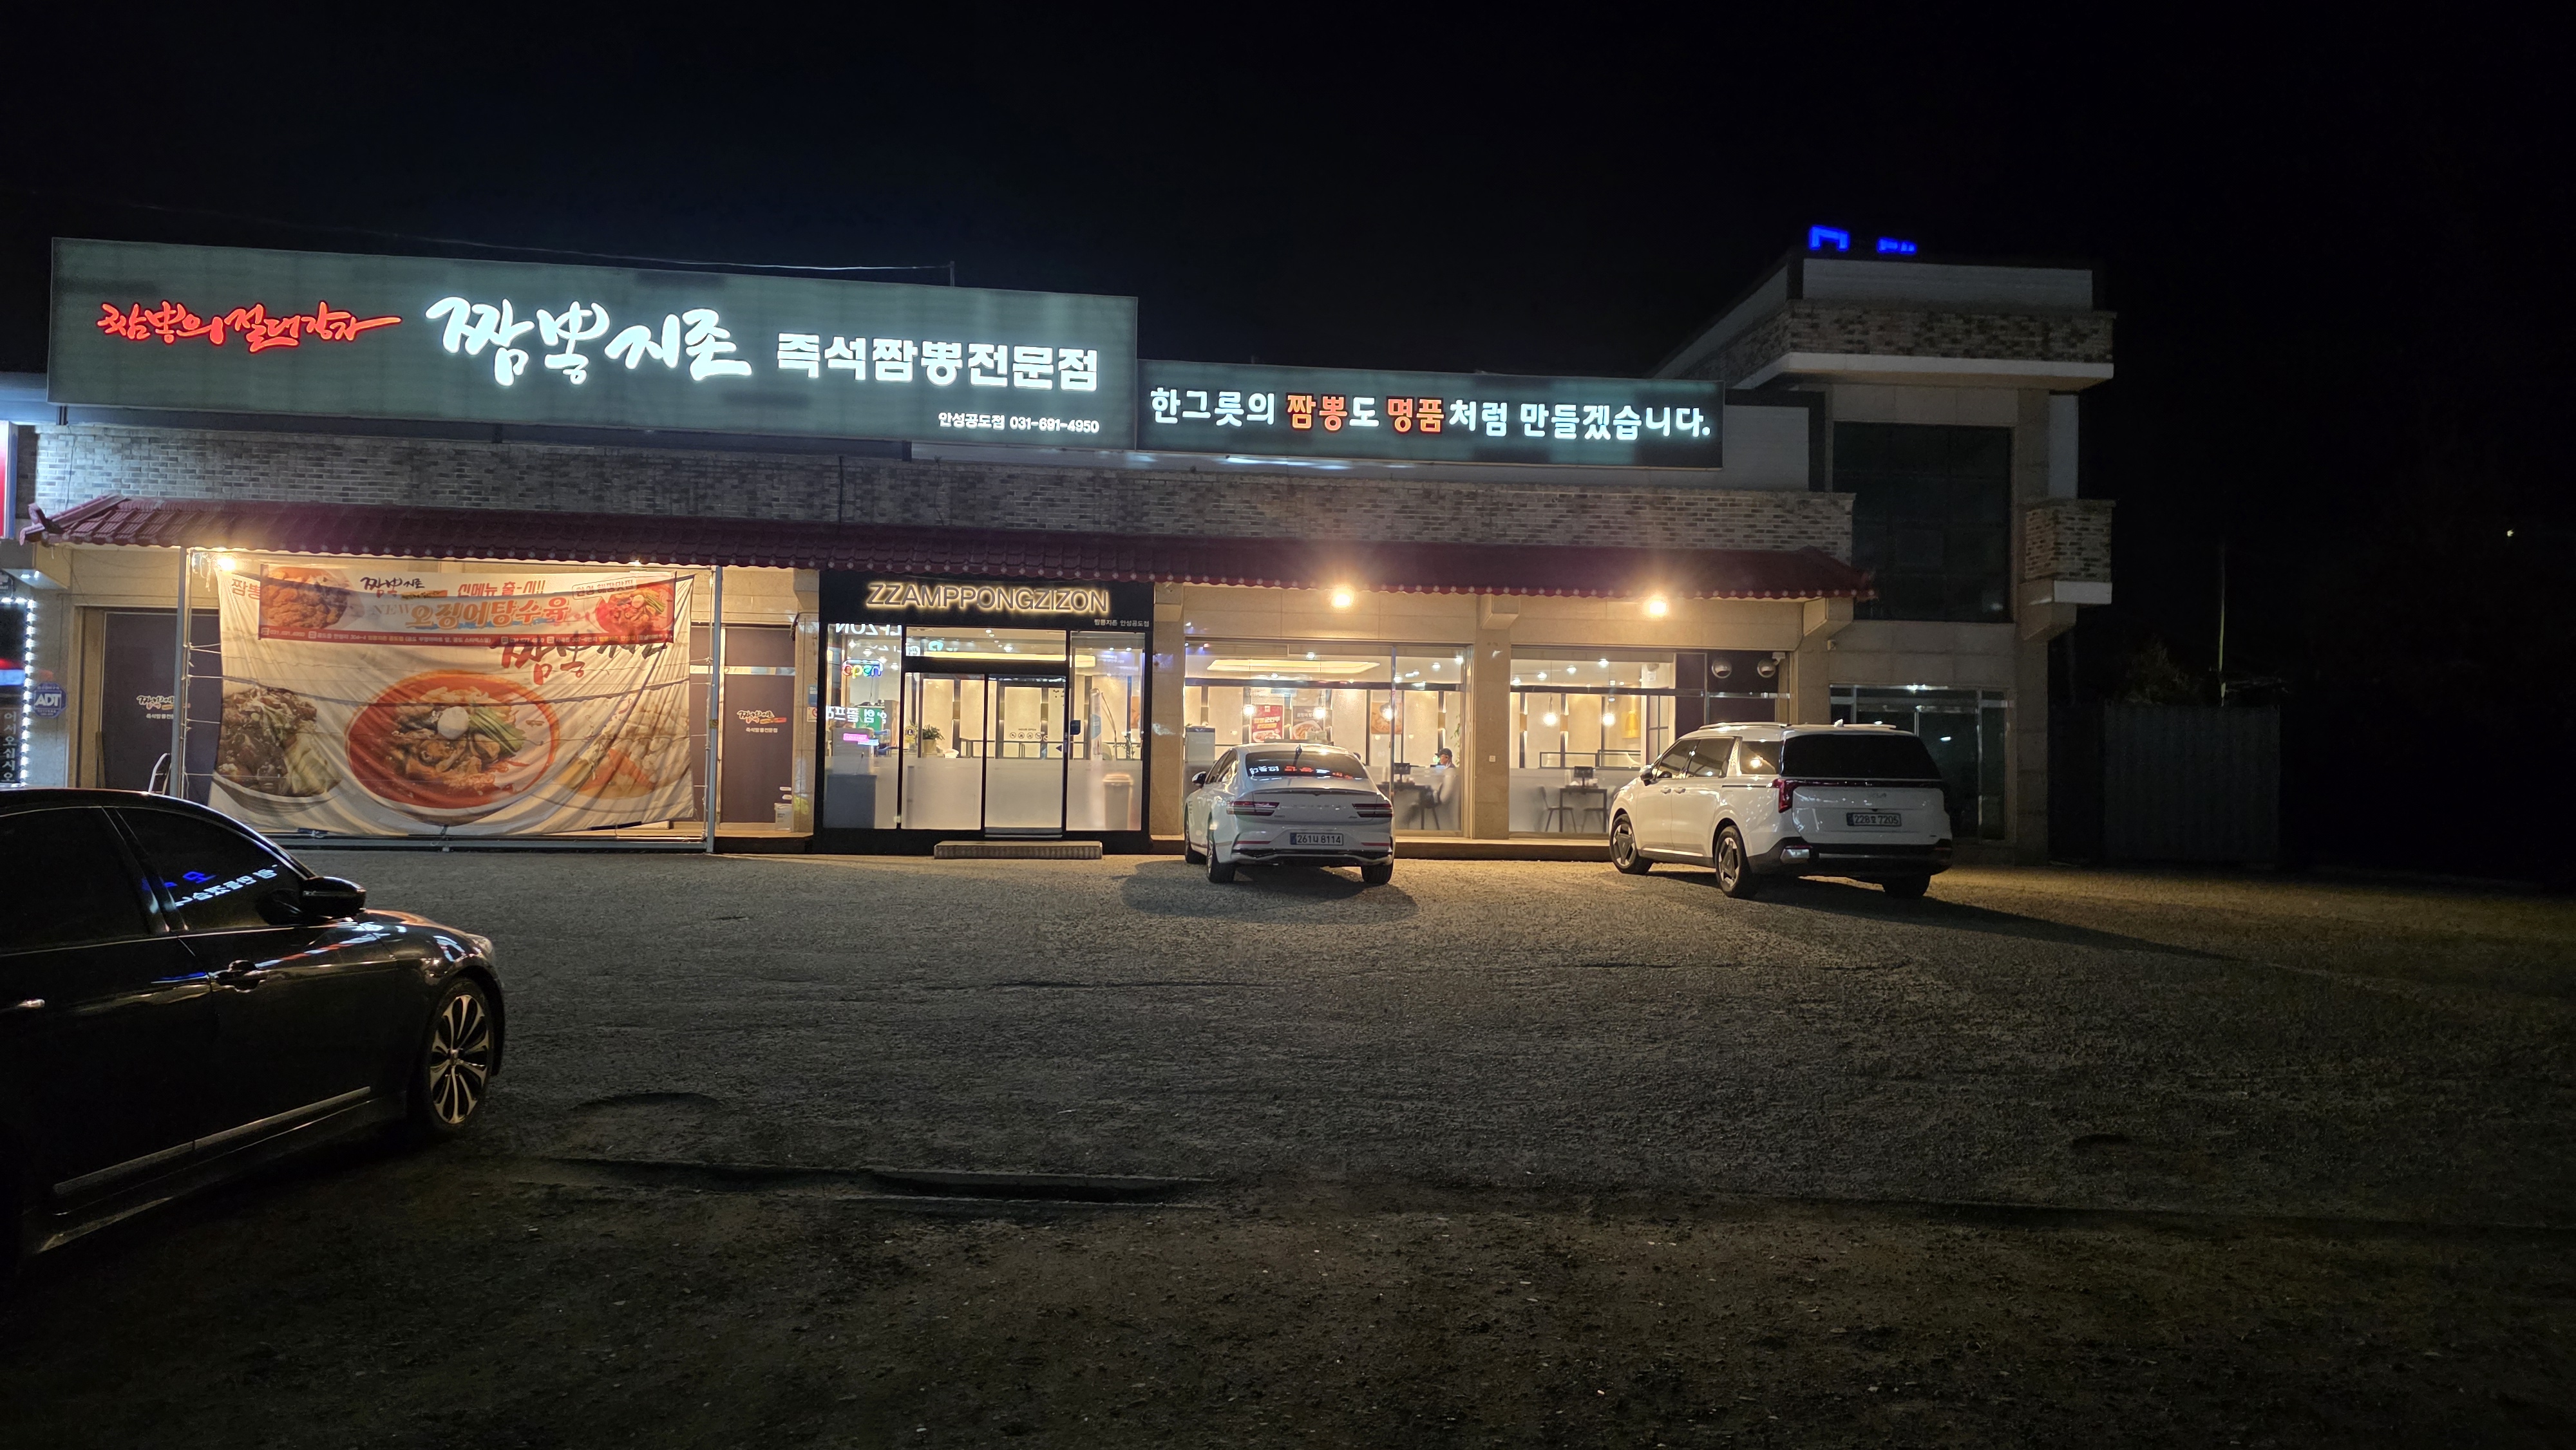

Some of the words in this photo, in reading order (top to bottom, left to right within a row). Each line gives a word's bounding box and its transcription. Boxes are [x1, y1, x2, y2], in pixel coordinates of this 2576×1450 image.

[776, 332, 1099, 391] 즉석짬뽕전문점
[938, 412, 1005, 430] 안성공도점
[1009, 417, 1100, 433] 031-691-4950
[1150, 387, 1276, 428] 한그릇의
[1285, 393, 1380, 432] 짬뽕도
[1386, 394, 1510, 435] 명품처럼
[1520, 401, 1712, 441] 만들겠습니다.
[458, 581, 498, 598] 신메뉴
[866, 583, 1109, 614] ZZAMPPONGZIZON
[405, 596, 570, 630] 오징어탕수육
[842, 664, 883, 679] open
[34, 693, 62, 706] ADT
[1, 711, 17, 782] 어서오십시오
[1321, 835, 1341, 843] 8114
